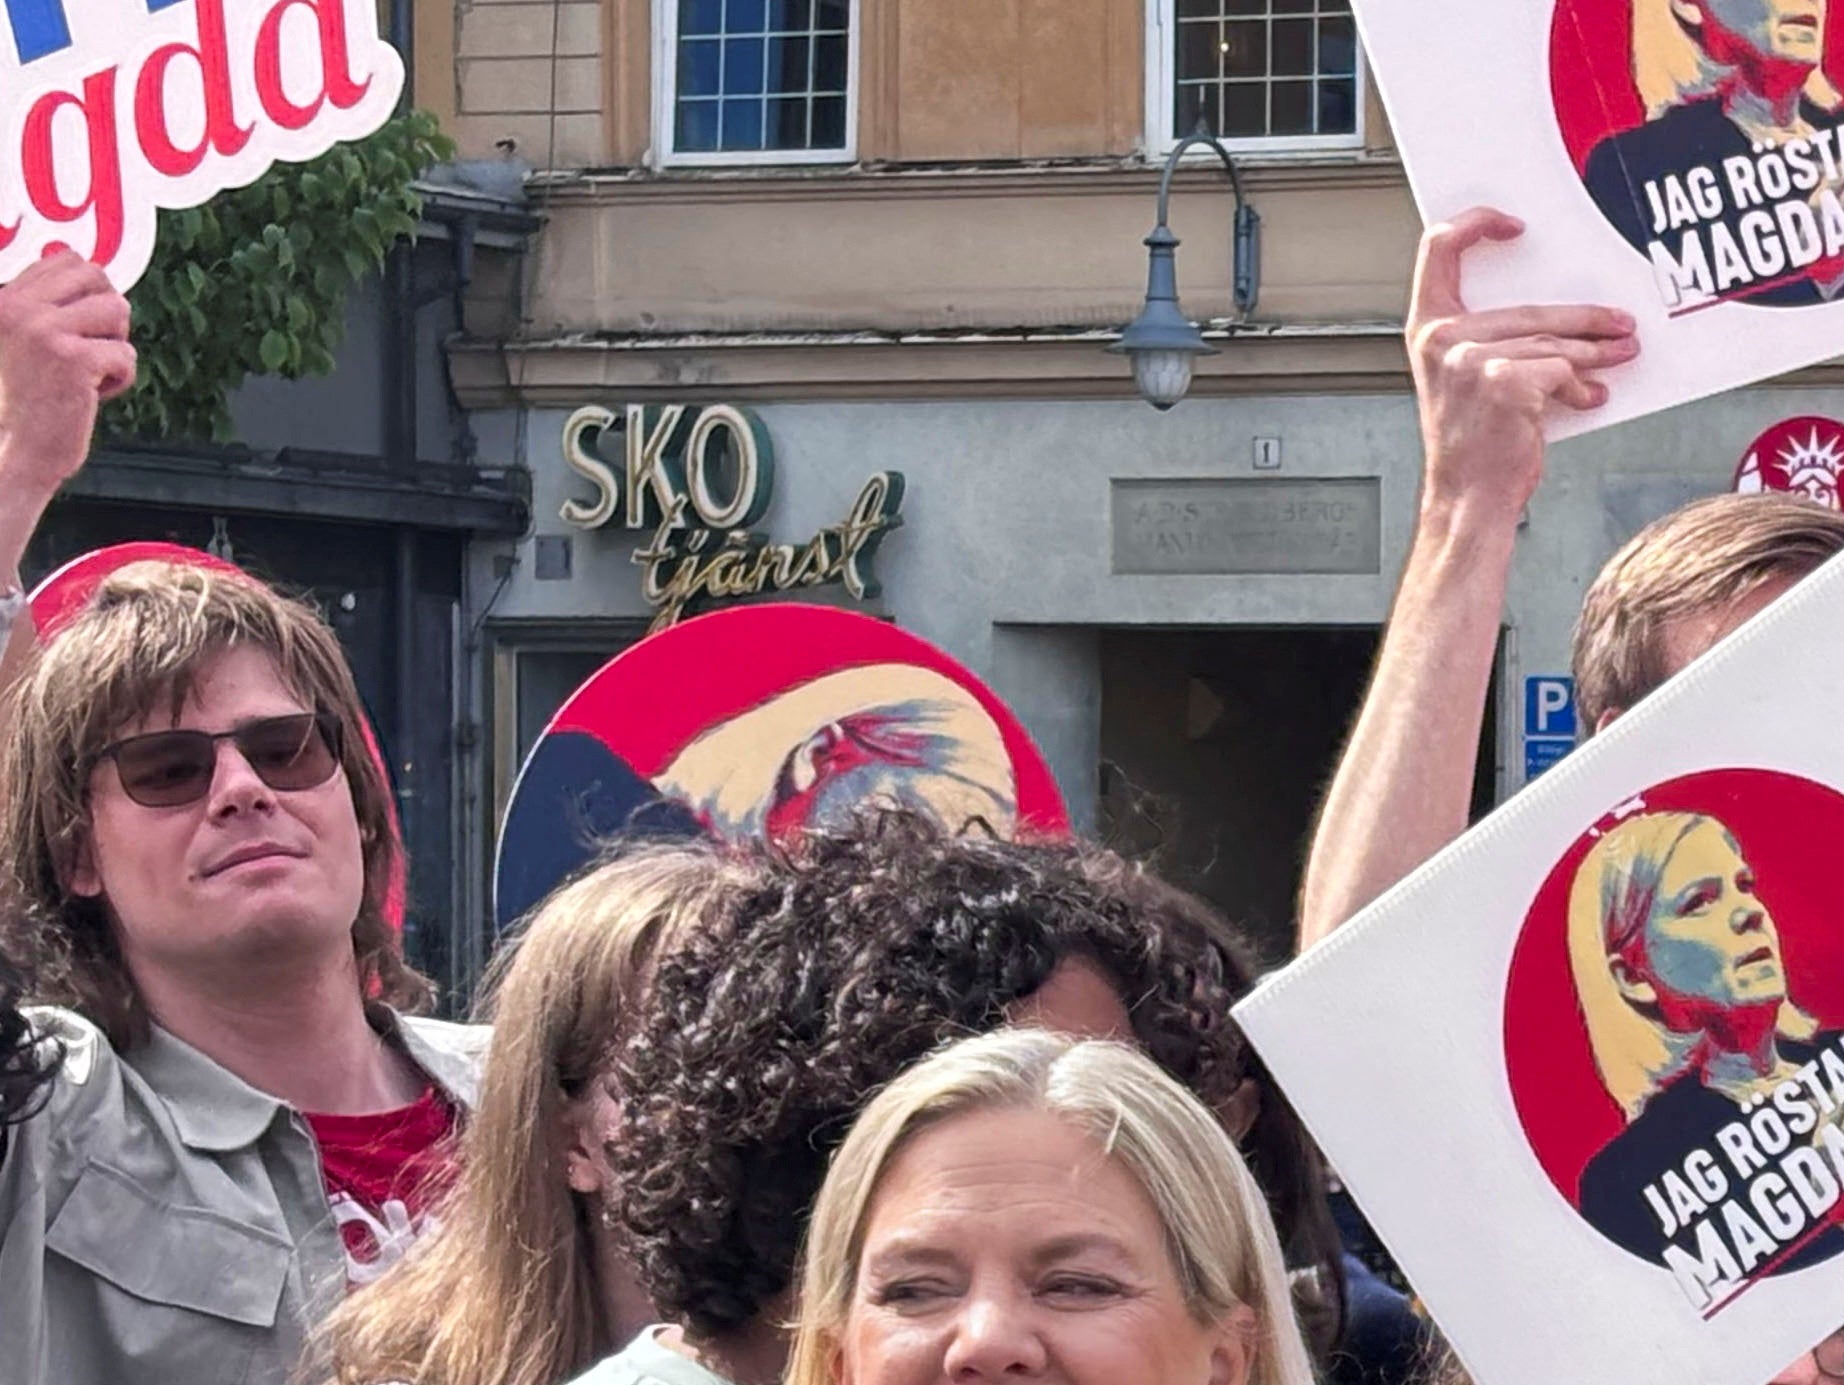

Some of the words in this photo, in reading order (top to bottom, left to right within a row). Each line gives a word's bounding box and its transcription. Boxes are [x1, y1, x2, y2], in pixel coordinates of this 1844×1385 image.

[0, 0, 374, 268] gda
[1644, 166, 1723, 234] JAG
[559, 404, 764, 529] SKO
[1263, 442, 1270, 464] 1
[630, 471, 896, 634] tjänst
[1537, 681, 1568, 731] P
[1643, 1149, 1729, 1238] JAG
